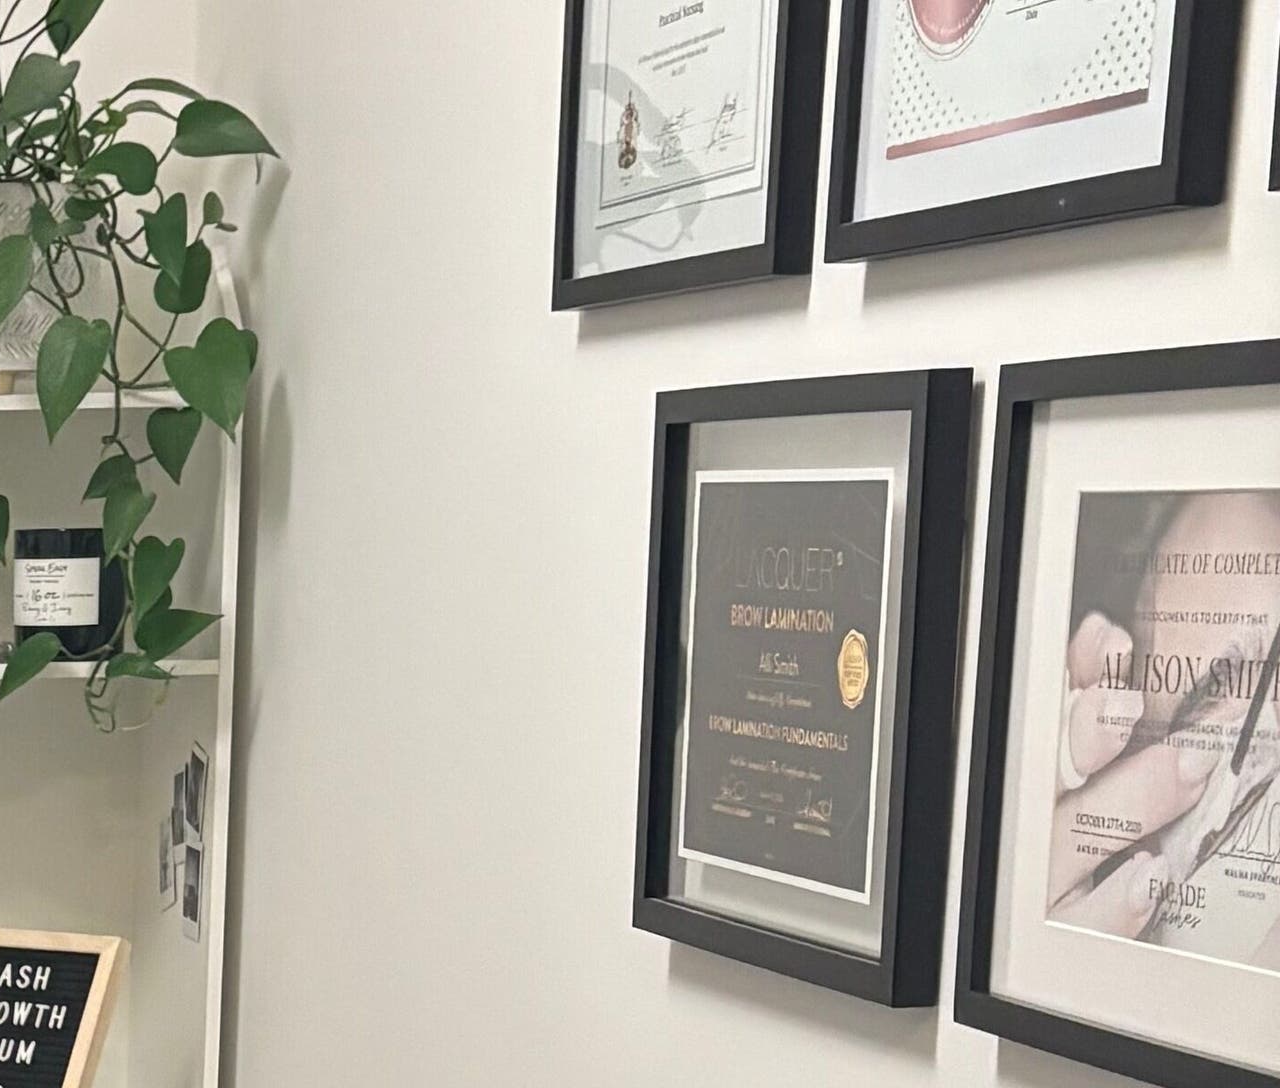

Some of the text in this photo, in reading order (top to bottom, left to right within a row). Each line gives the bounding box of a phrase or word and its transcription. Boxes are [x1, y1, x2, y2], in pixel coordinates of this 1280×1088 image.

[1192, 553, 1210, 574] OF
[730, 604, 834, 633] BROW LAMINATION
[1098, 651, 1202, 696] ALLISON
